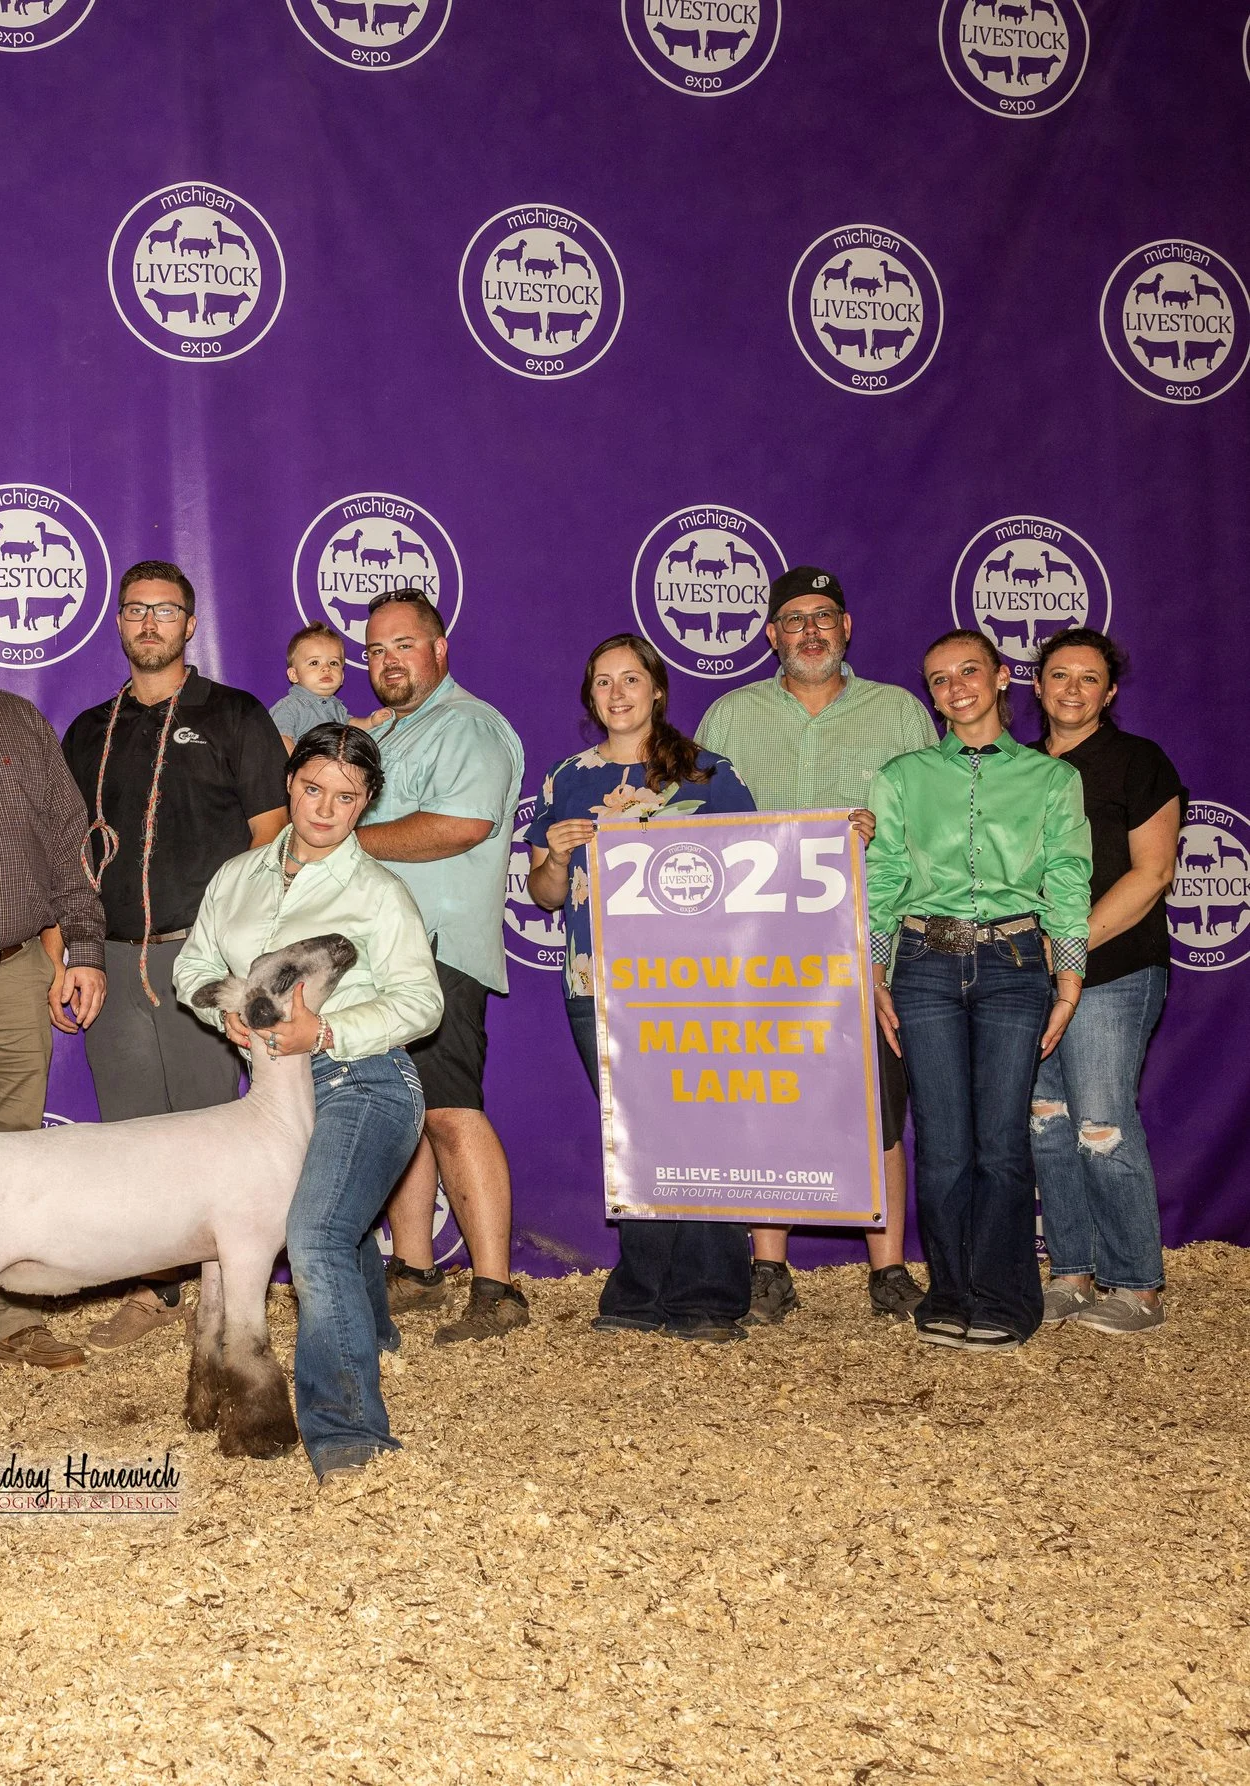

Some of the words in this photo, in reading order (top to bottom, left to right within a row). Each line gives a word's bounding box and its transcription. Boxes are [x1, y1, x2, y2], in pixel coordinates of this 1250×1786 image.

[961, 24, 1066, 50] LIVESTOCK
[352, 49, 390, 66] expo
[685, 74, 722, 91] expo
[1000, 99, 1035, 114] expo
[161, 187, 235, 212] michigan
[507, 209, 578, 233] michigan
[833, 229, 901, 253] michigan
[1143, 244, 1210, 267] michigan
[136, 263, 258, 287] LIVESTOCK
[484, 280, 600, 305] LIVESTOCK
[813, 298, 920, 323] LIVESTOCK
[1125, 312, 1232, 334] LIVESTOCK
[180, 341, 222, 358] expo
[525, 358, 564, 375] expo
[851, 374, 888, 390] expo
[1165, 384, 1200, 400] expo
[342, 498, 415, 522] michigan
[678, 510, 747, 533] michigan
[995, 520, 1062, 542] michigan
[657, 582, 768, 605] LIVESTOCK
[975, 590, 1086, 611] LIVESTOCK
[2, 647, 44, 664] expo
[696, 658, 734, 675] expo
[668, 843, 702, 855] michigan
[659, 873, 713, 885] LIVESTOCK
[680, 905, 699, 914] expo
[537, 949, 565, 967] exp
[1188, 950, 1225, 967] expo
[610, 954, 854, 990] SHOWCASE
[638, 1020, 832, 1055] MARKET
[670, 1069, 802, 1105] LAMB
[656, 1167, 720, 1181] BELIEVE
[729, 1168, 777, 1183] BUILD
[785, 1170, 834, 1185] GROW
[652, 1186, 679, 1197] OUR
[680, 1187, 723, 1199] YOUTH,
[726, 1188, 753, 1199] OUR
[754, 1189, 839, 1203] AGRICULTURE
